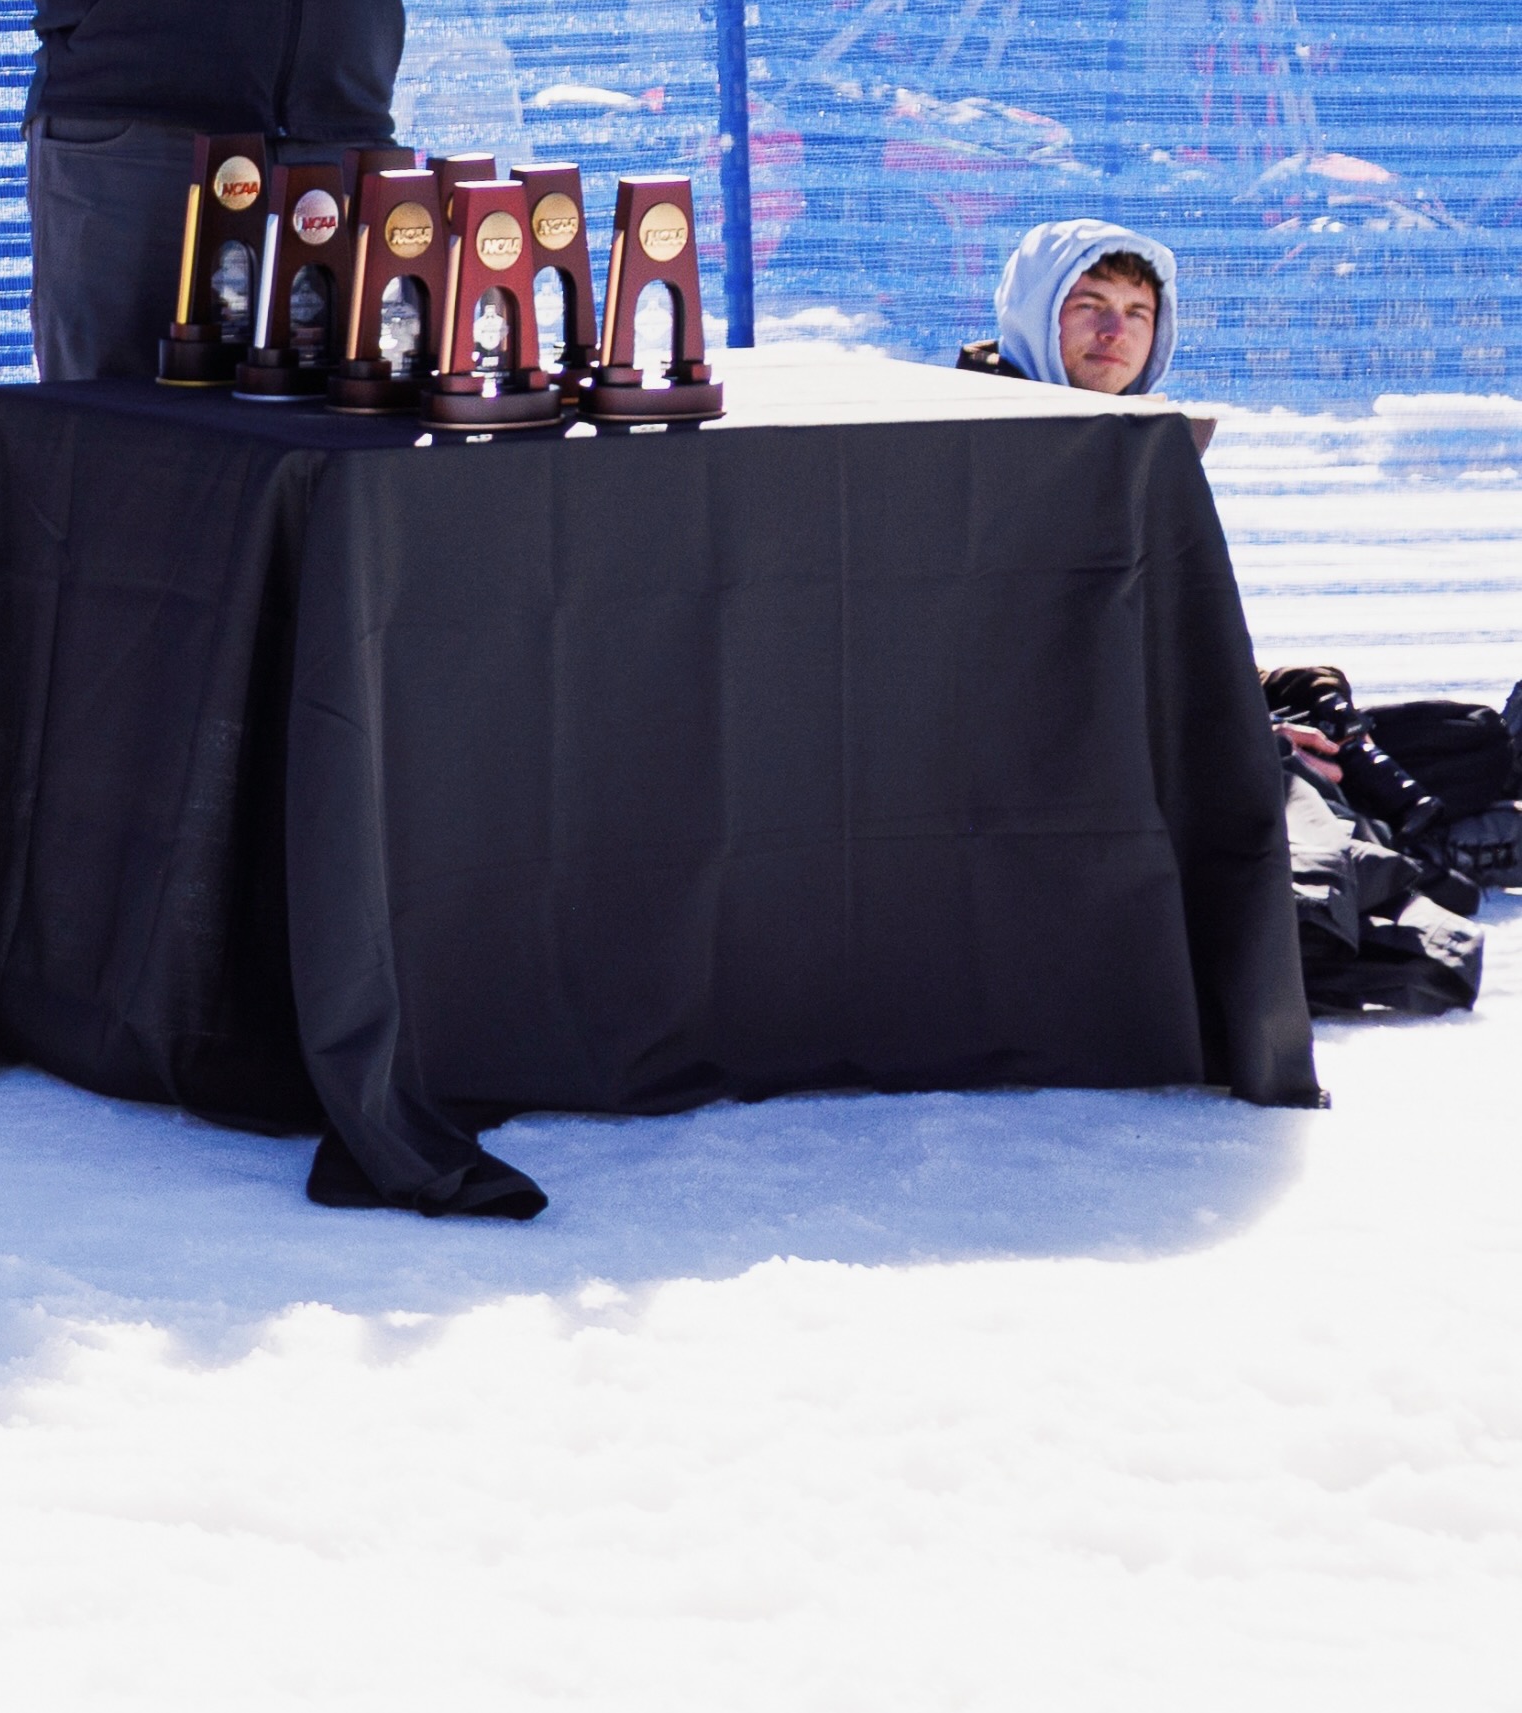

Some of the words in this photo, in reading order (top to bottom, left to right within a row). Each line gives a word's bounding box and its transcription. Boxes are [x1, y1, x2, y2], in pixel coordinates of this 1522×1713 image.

[222, 181, 259, 197] NCAA
[301, 216, 337, 231] NCAA
[481, 237, 521, 255] NCAA
